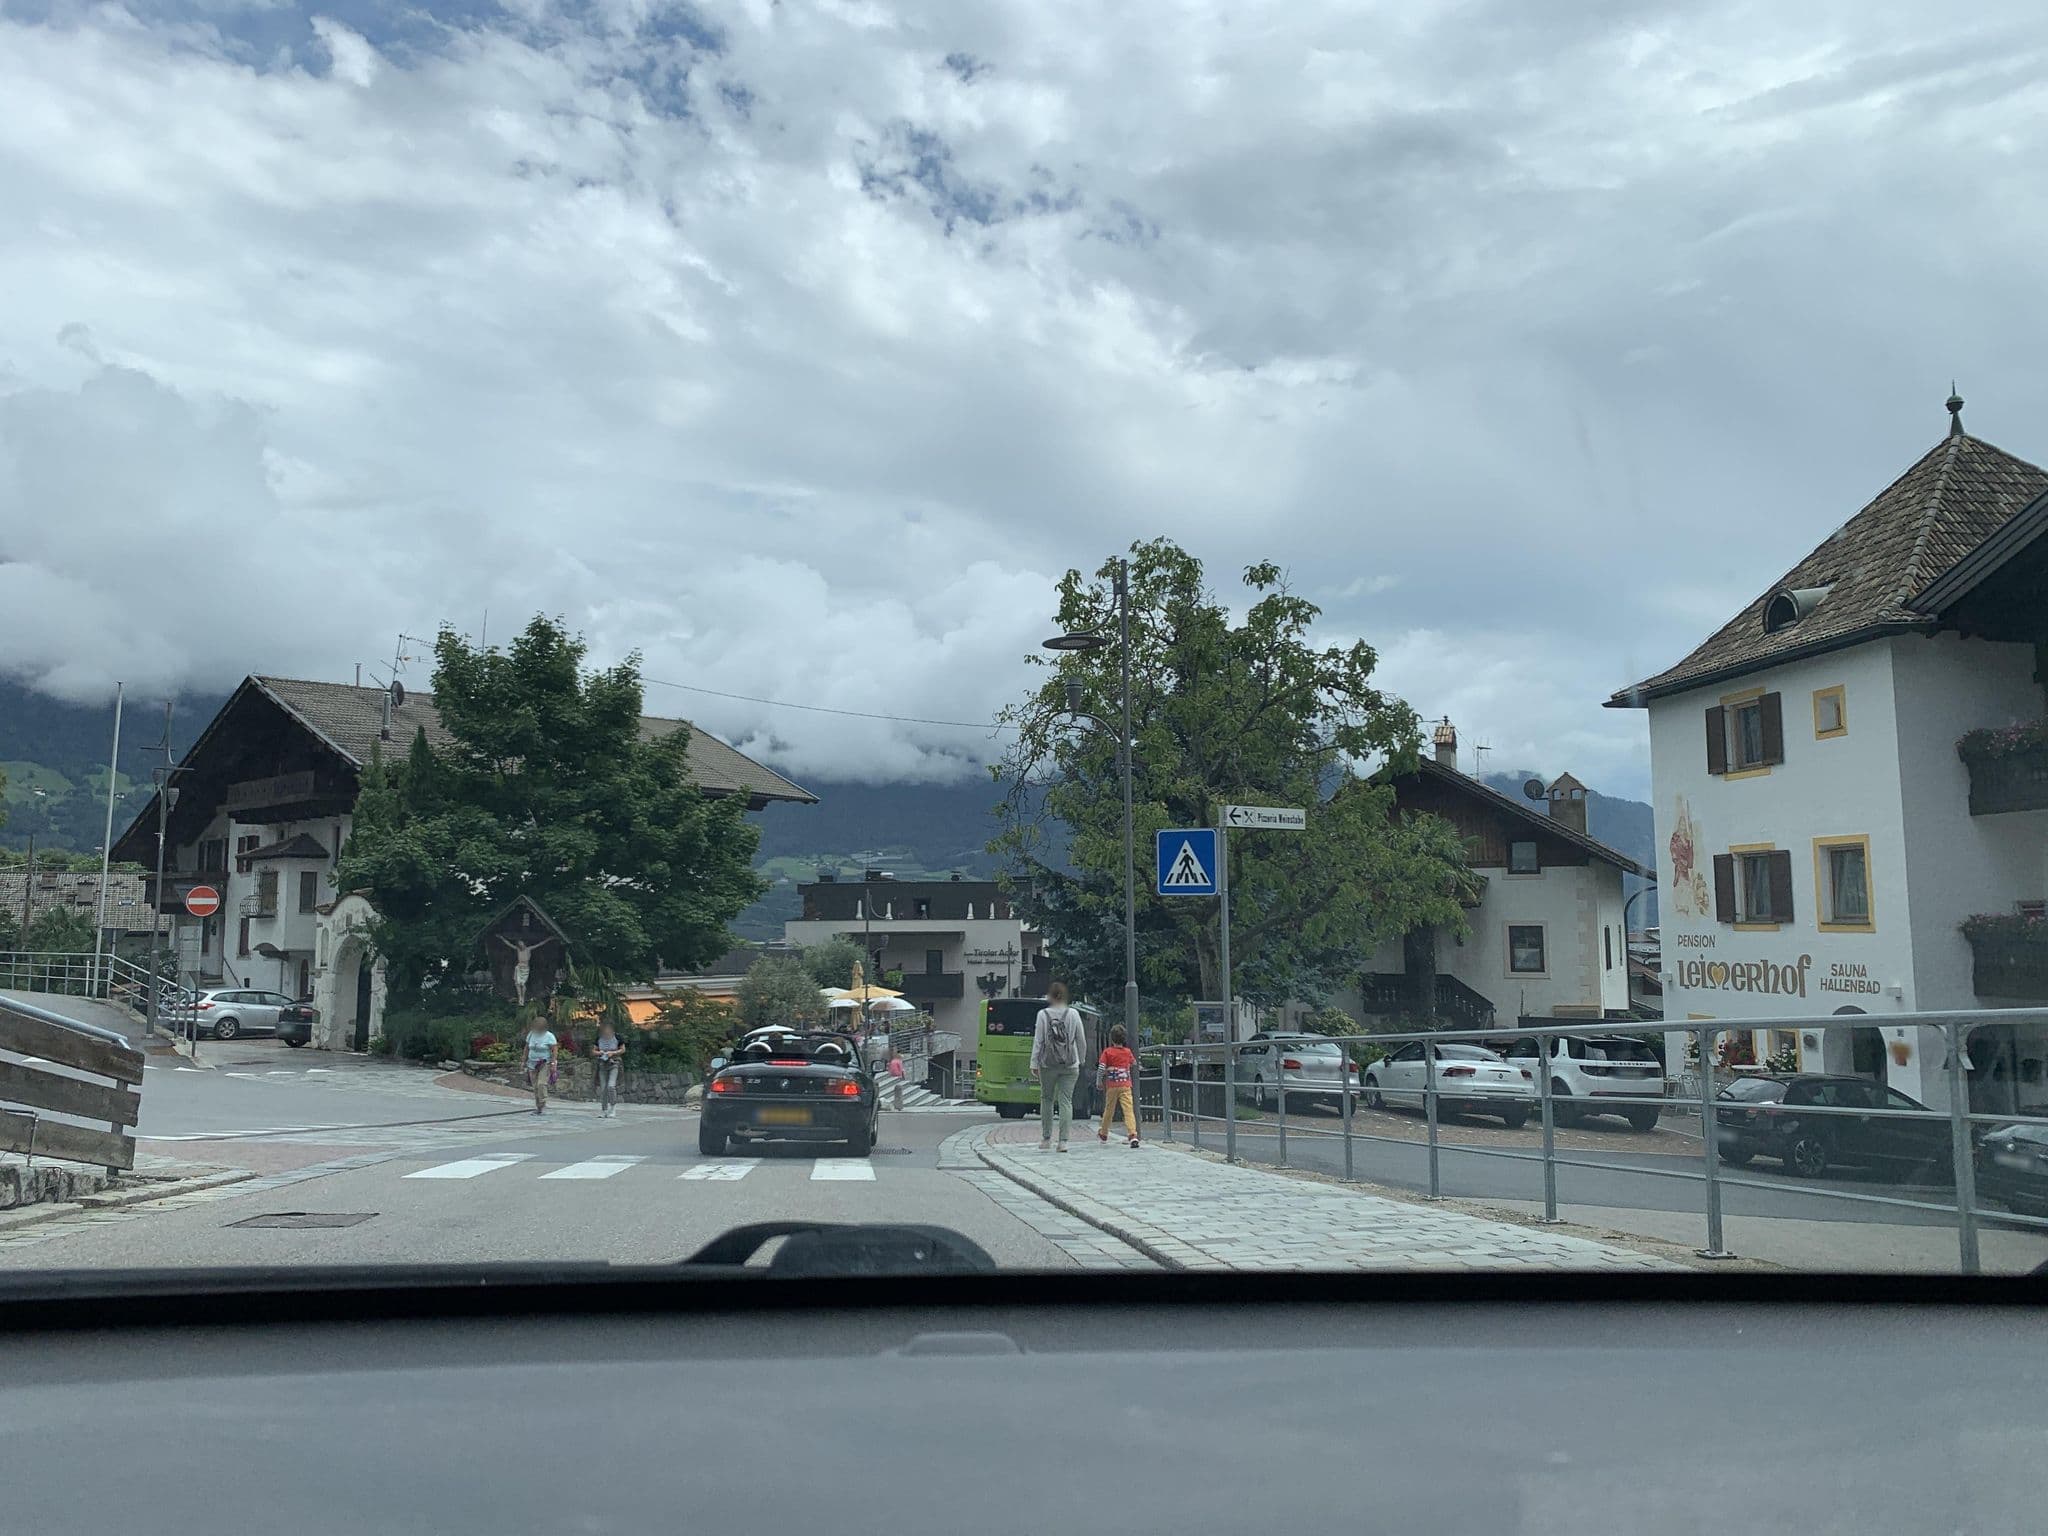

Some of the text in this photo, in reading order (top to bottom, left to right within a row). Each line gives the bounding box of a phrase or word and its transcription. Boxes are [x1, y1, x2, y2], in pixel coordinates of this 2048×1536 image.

[1677, 934, 1716, 948] PENSION
[974, 948, 998, 957] Tiroler
[1830, 963, 1868, 978] SAUNA
[1820, 977, 1881, 995] HALLENBAD
